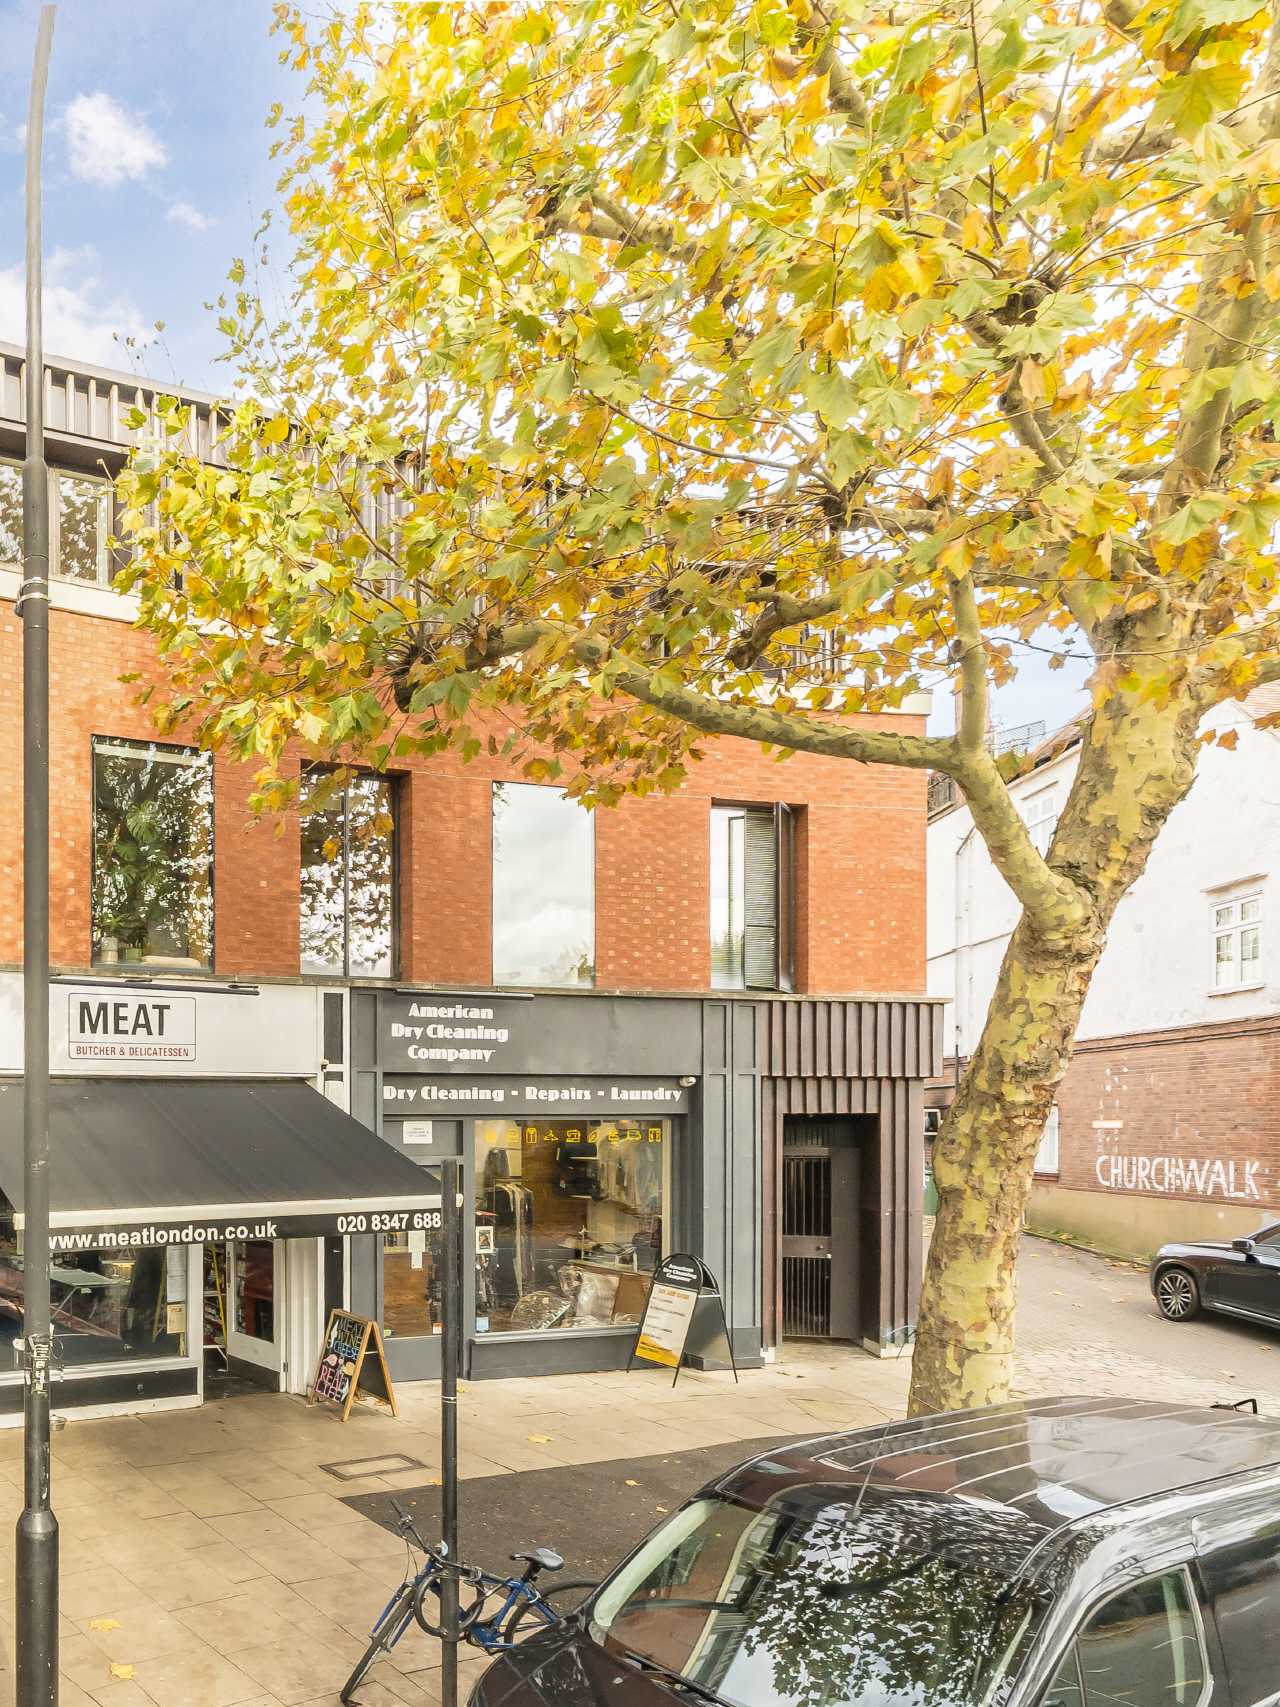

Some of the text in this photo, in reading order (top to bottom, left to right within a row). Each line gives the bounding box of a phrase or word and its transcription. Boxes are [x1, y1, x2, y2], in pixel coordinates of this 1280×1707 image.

[79, 1001, 171, 1036] MEAT
[408, 1002, 494, 1019] American
[391, 1023, 509, 1042] Dry Cleaning
[76, 1046, 189, 1057] BUTCHER & DELICATESSEN
[407, 1044, 496, 1062] Company
[383, 1085, 417, 1102] Dry
[420, 1086, 505, 1102] Cleaning
[525, 1086, 592, 1102] Repairs
[610, 1086, 683, 1103] Laundry
[337, 1212, 442, 1233] 020 8347 688
